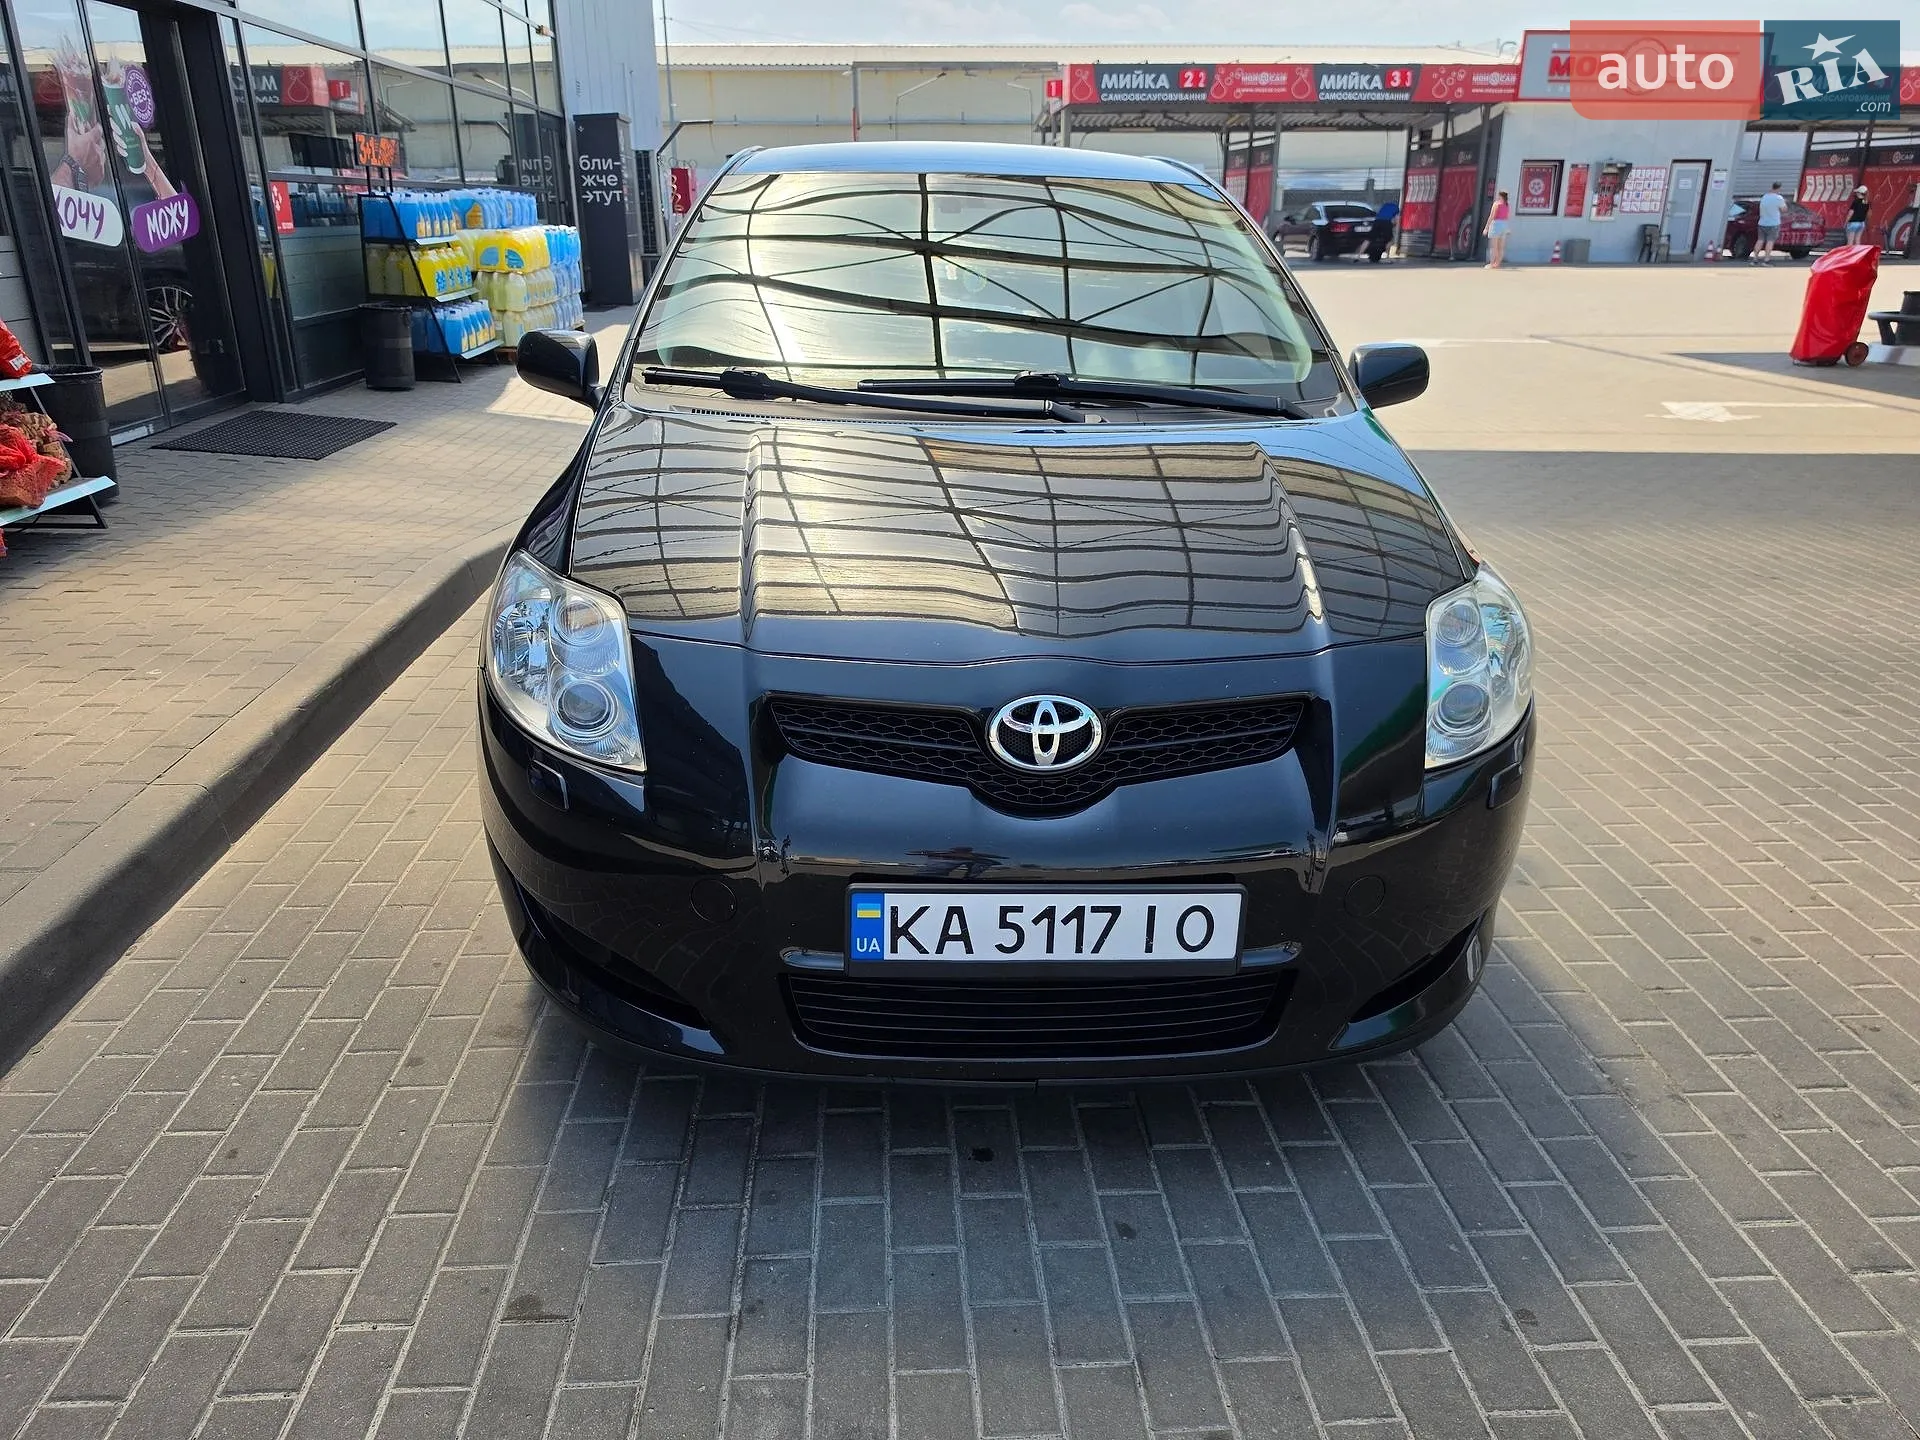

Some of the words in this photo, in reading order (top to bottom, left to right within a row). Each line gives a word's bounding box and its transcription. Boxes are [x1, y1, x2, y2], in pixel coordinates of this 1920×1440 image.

[1101, 70, 1170, 89] МИЙКА
[1320, 71, 1383, 90] МИЙКА
[132, 88, 148, 106] БЕЗ
[580, 155, 621, 171] бли-
[581, 174, 618, 187] жче
[593, 190, 622, 206] тут
[146, 198, 189, 245] МОЖУ
[890, 905, 975, 954] KA
[994, 905, 1123, 955] 5117
[856, 937, 882, 954] UA
